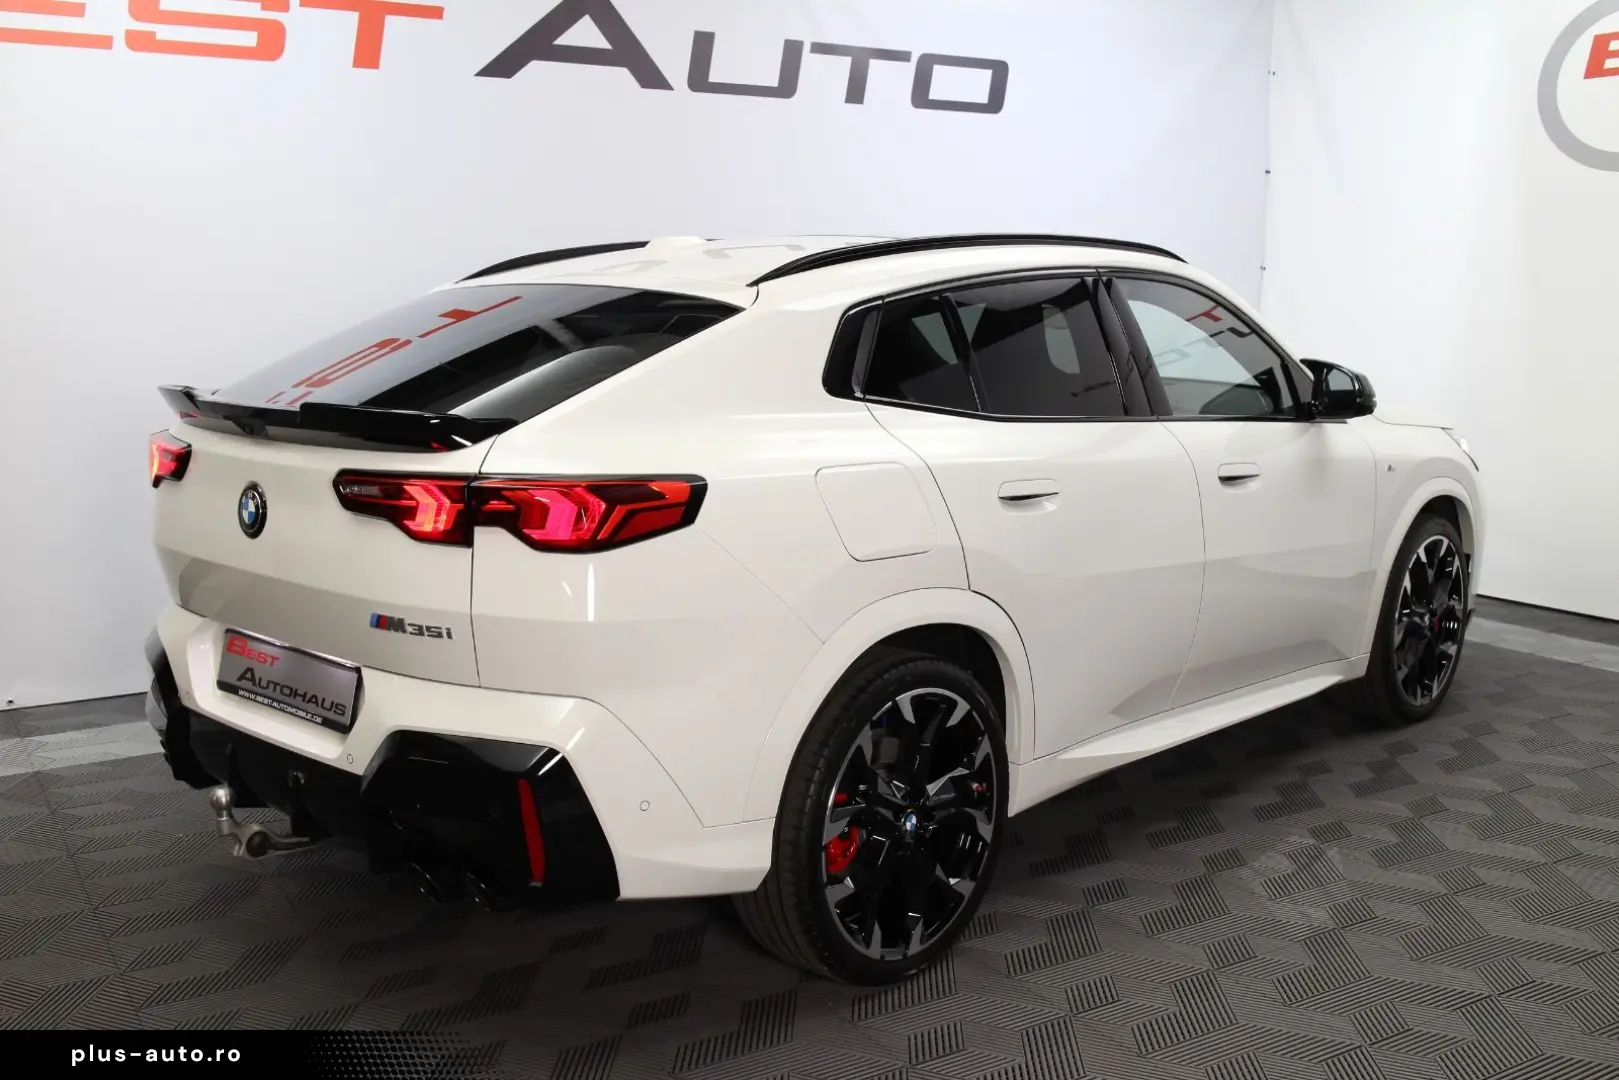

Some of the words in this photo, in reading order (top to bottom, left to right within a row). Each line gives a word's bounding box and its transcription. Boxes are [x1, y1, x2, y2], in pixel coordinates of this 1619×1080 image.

[474, 0, 1009, 115] AUTO
[386, 615, 454, 640] M35i
[226, 634, 280, 667] BEST
[236, 666, 347, 717] AUTOHAUS
